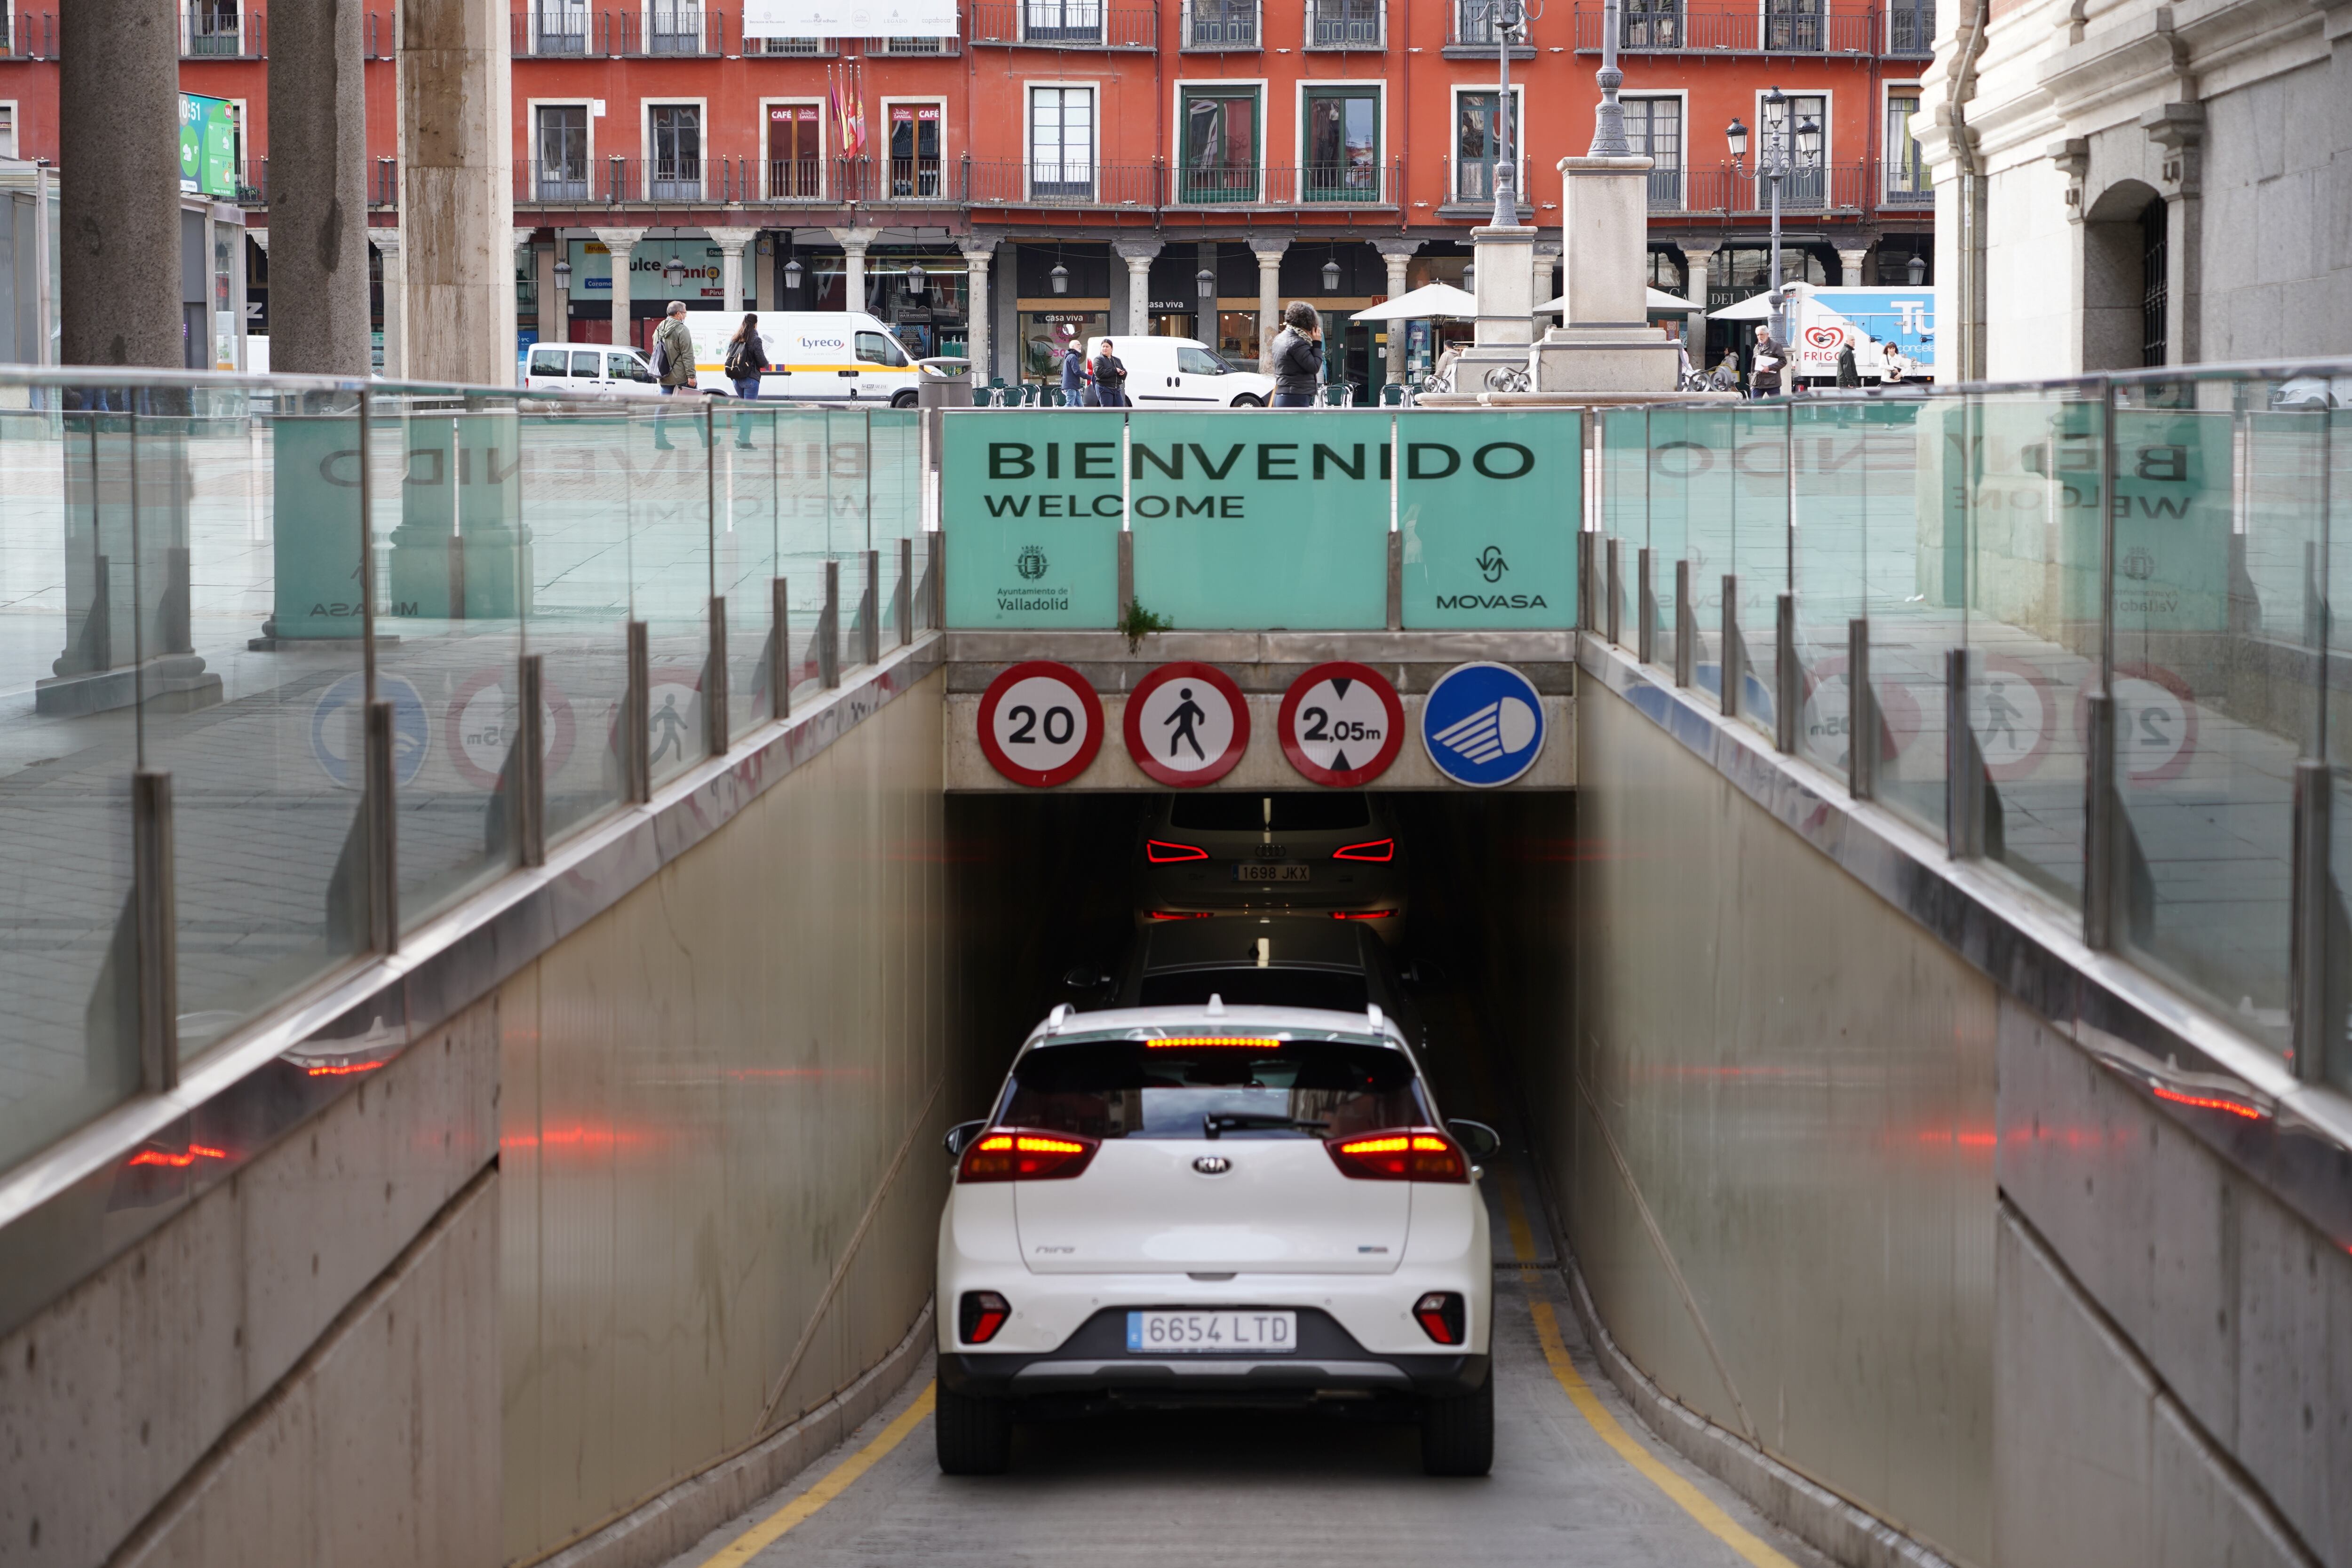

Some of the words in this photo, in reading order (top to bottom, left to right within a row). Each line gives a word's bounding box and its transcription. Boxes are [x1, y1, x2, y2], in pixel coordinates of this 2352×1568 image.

[771, 110, 792, 119] CAFÉ
[919, 109, 939, 118] CAFÉ
[629, 258, 661, 271] ulce
[663, 265, 718, 278] anía
[1710, 293, 1738, 304] DEL
[803, 338, 842, 349] Lyreco
[988, 442, 1535, 480] BIENVENIDO
[984, 494, 1245, 518] WELCOME
[998, 598, 1068, 610] Valladolid
[1437, 594, 1548, 609] MOVASA
[1009, 705, 1074, 744] 20
[1303, 706, 1381, 743] 2,05m
[1244, 866, 1277, 879] 1698
[1282, 866, 1307, 879] JKX
[1198, 1158, 1225, 1172] KIA
[1149, 1317, 1222, 1343] 6654
[1233, 1317, 1288, 1343] LTD
